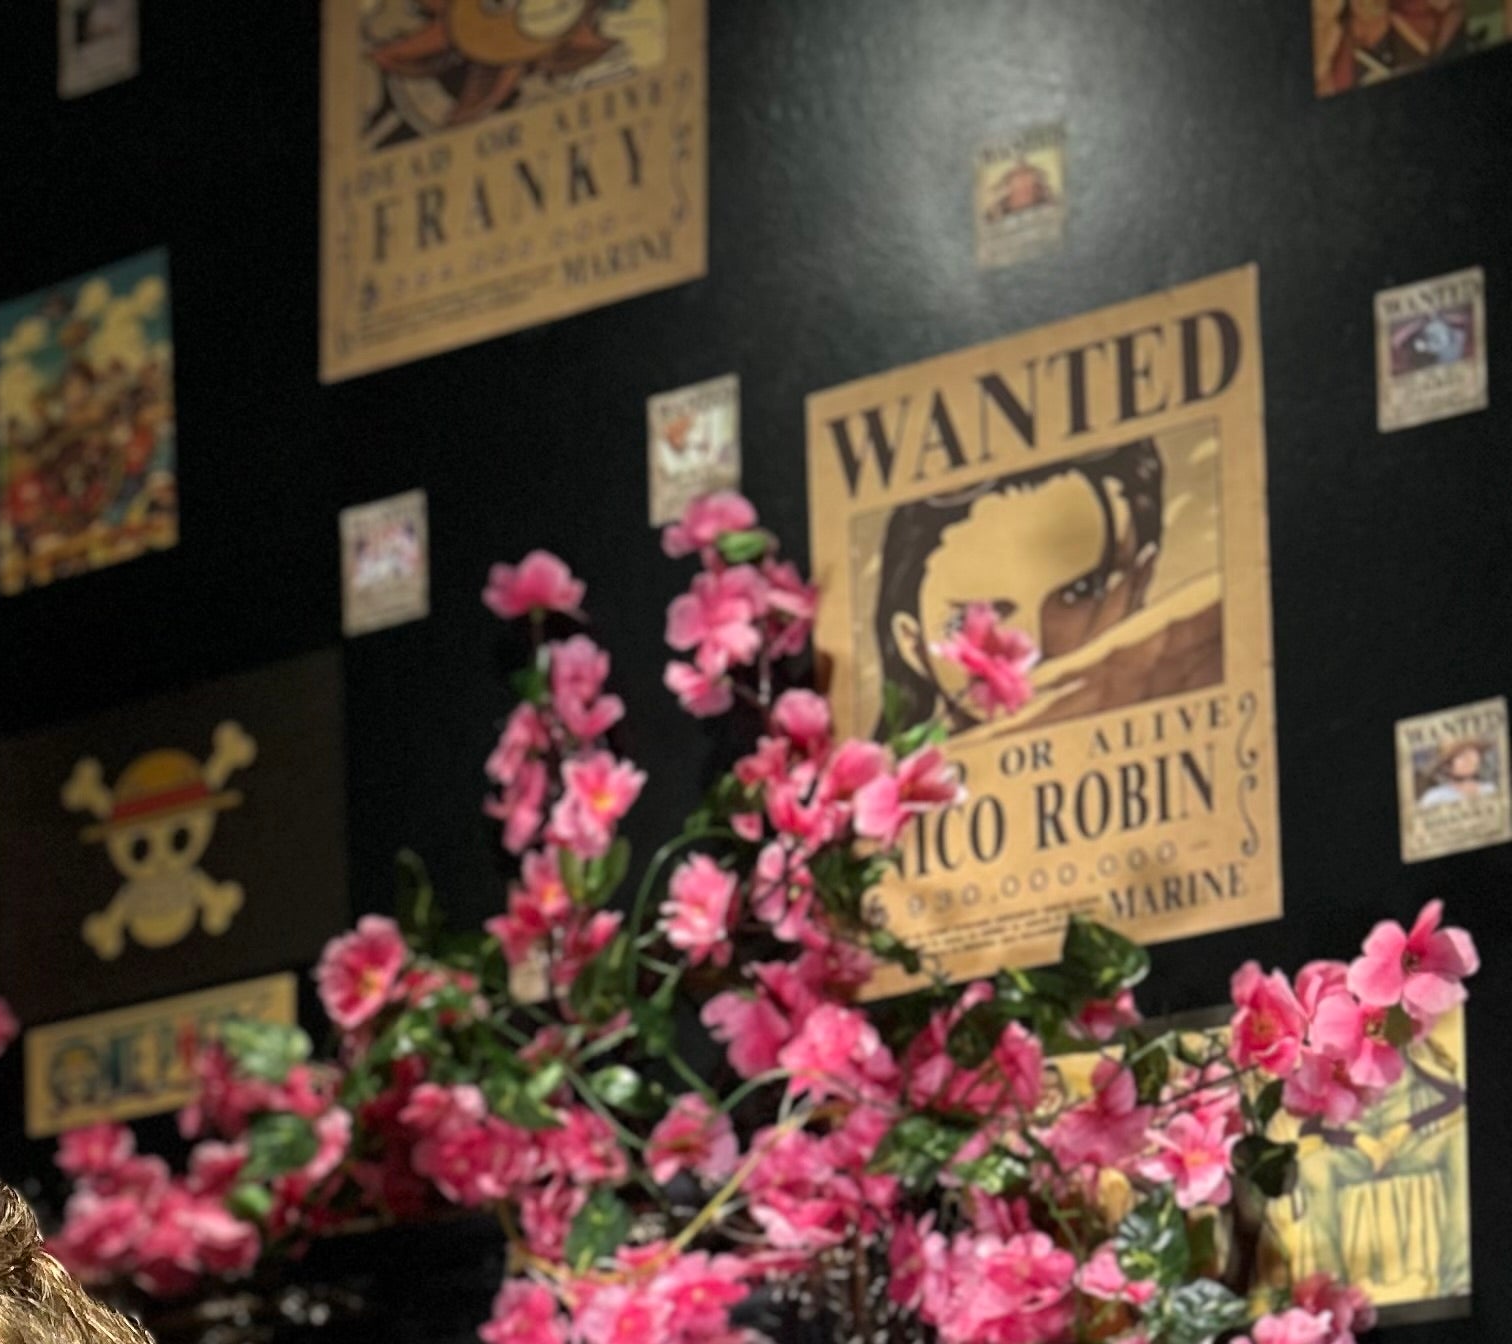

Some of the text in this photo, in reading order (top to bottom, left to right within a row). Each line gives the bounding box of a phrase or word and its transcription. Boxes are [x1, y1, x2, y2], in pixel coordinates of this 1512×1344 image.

[371, 118, 652, 263] FRANKY
[826, 308, 1242, 498] WANTED
[999, 738, 1055, 779] OR
[1092, 694, 1231, 756] ALIVE
[1034, 742, 1219, 852] ROBIN
[1106, 862, 1248, 919] MARINE
